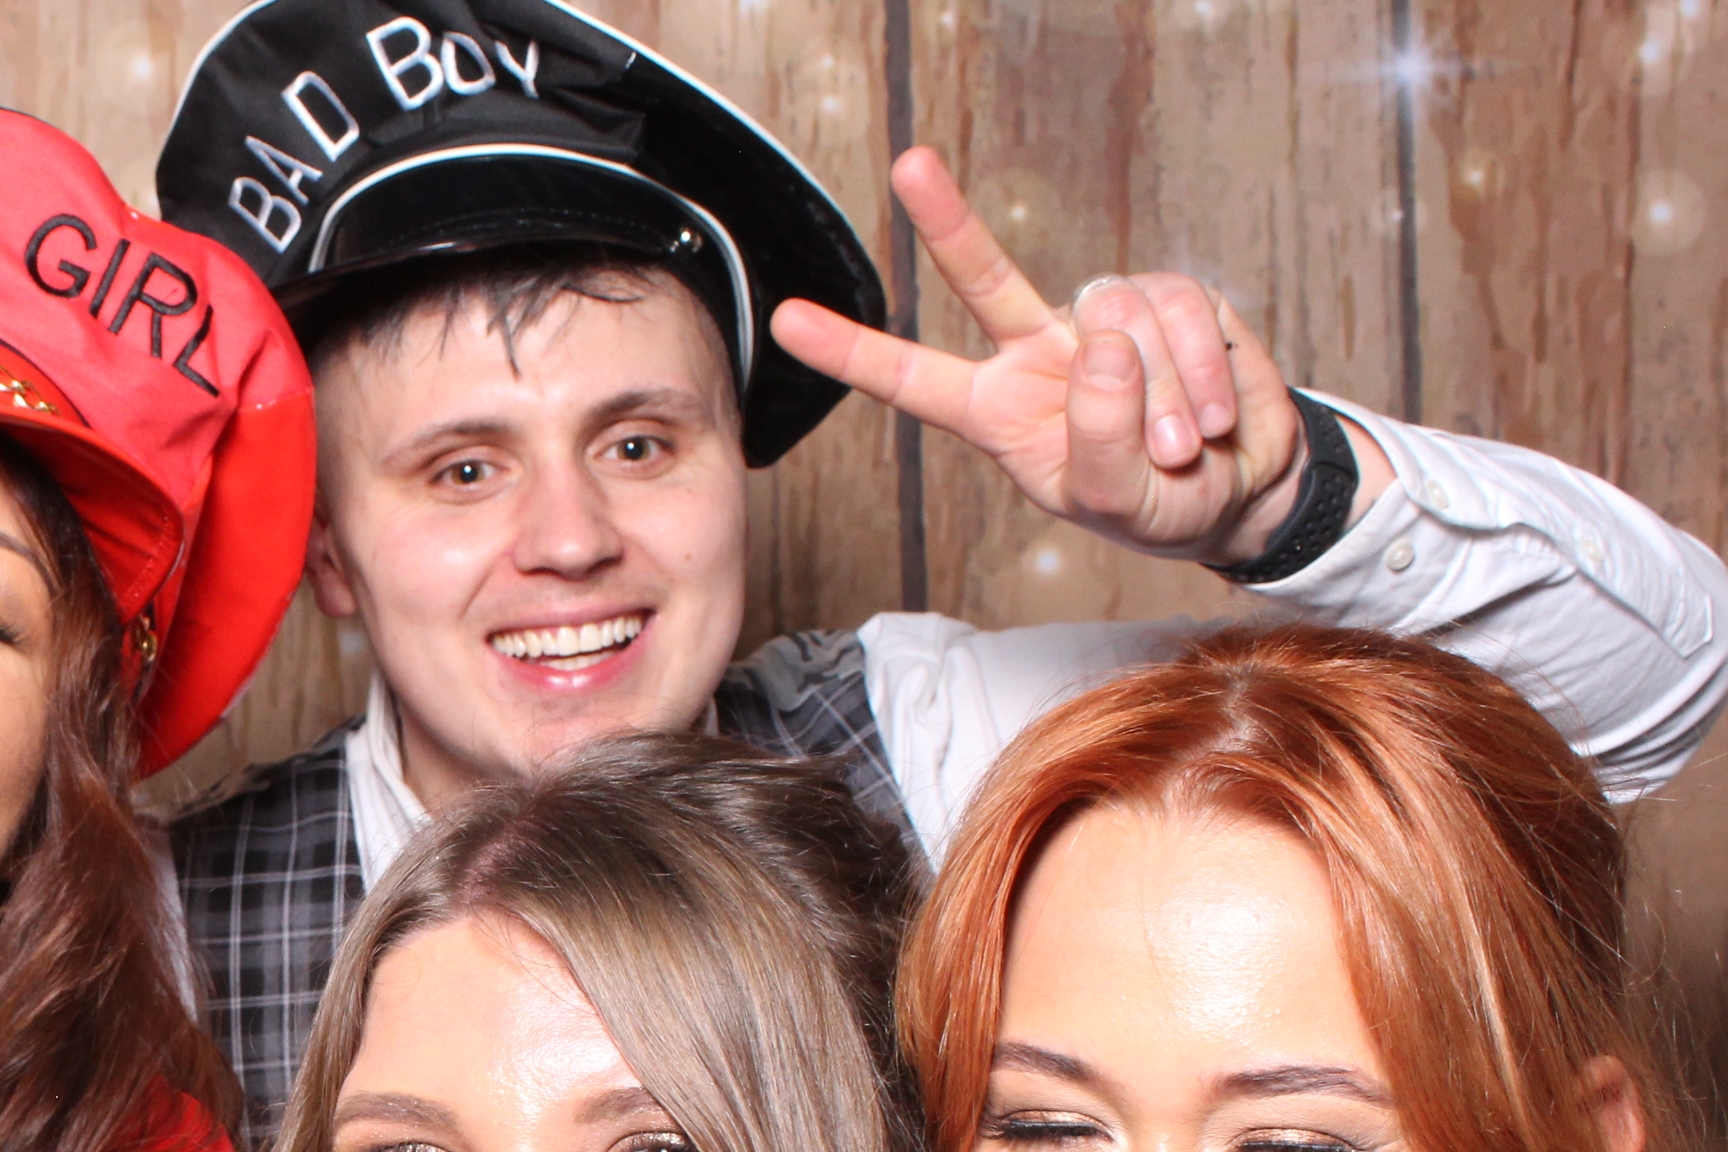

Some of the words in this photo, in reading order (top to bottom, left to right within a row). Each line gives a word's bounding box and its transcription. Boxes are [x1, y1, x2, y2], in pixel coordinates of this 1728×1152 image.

[228, 71, 360, 254] BAD
[366, 16, 540, 111] BOY
[24, 213, 221, 398] GIRL
